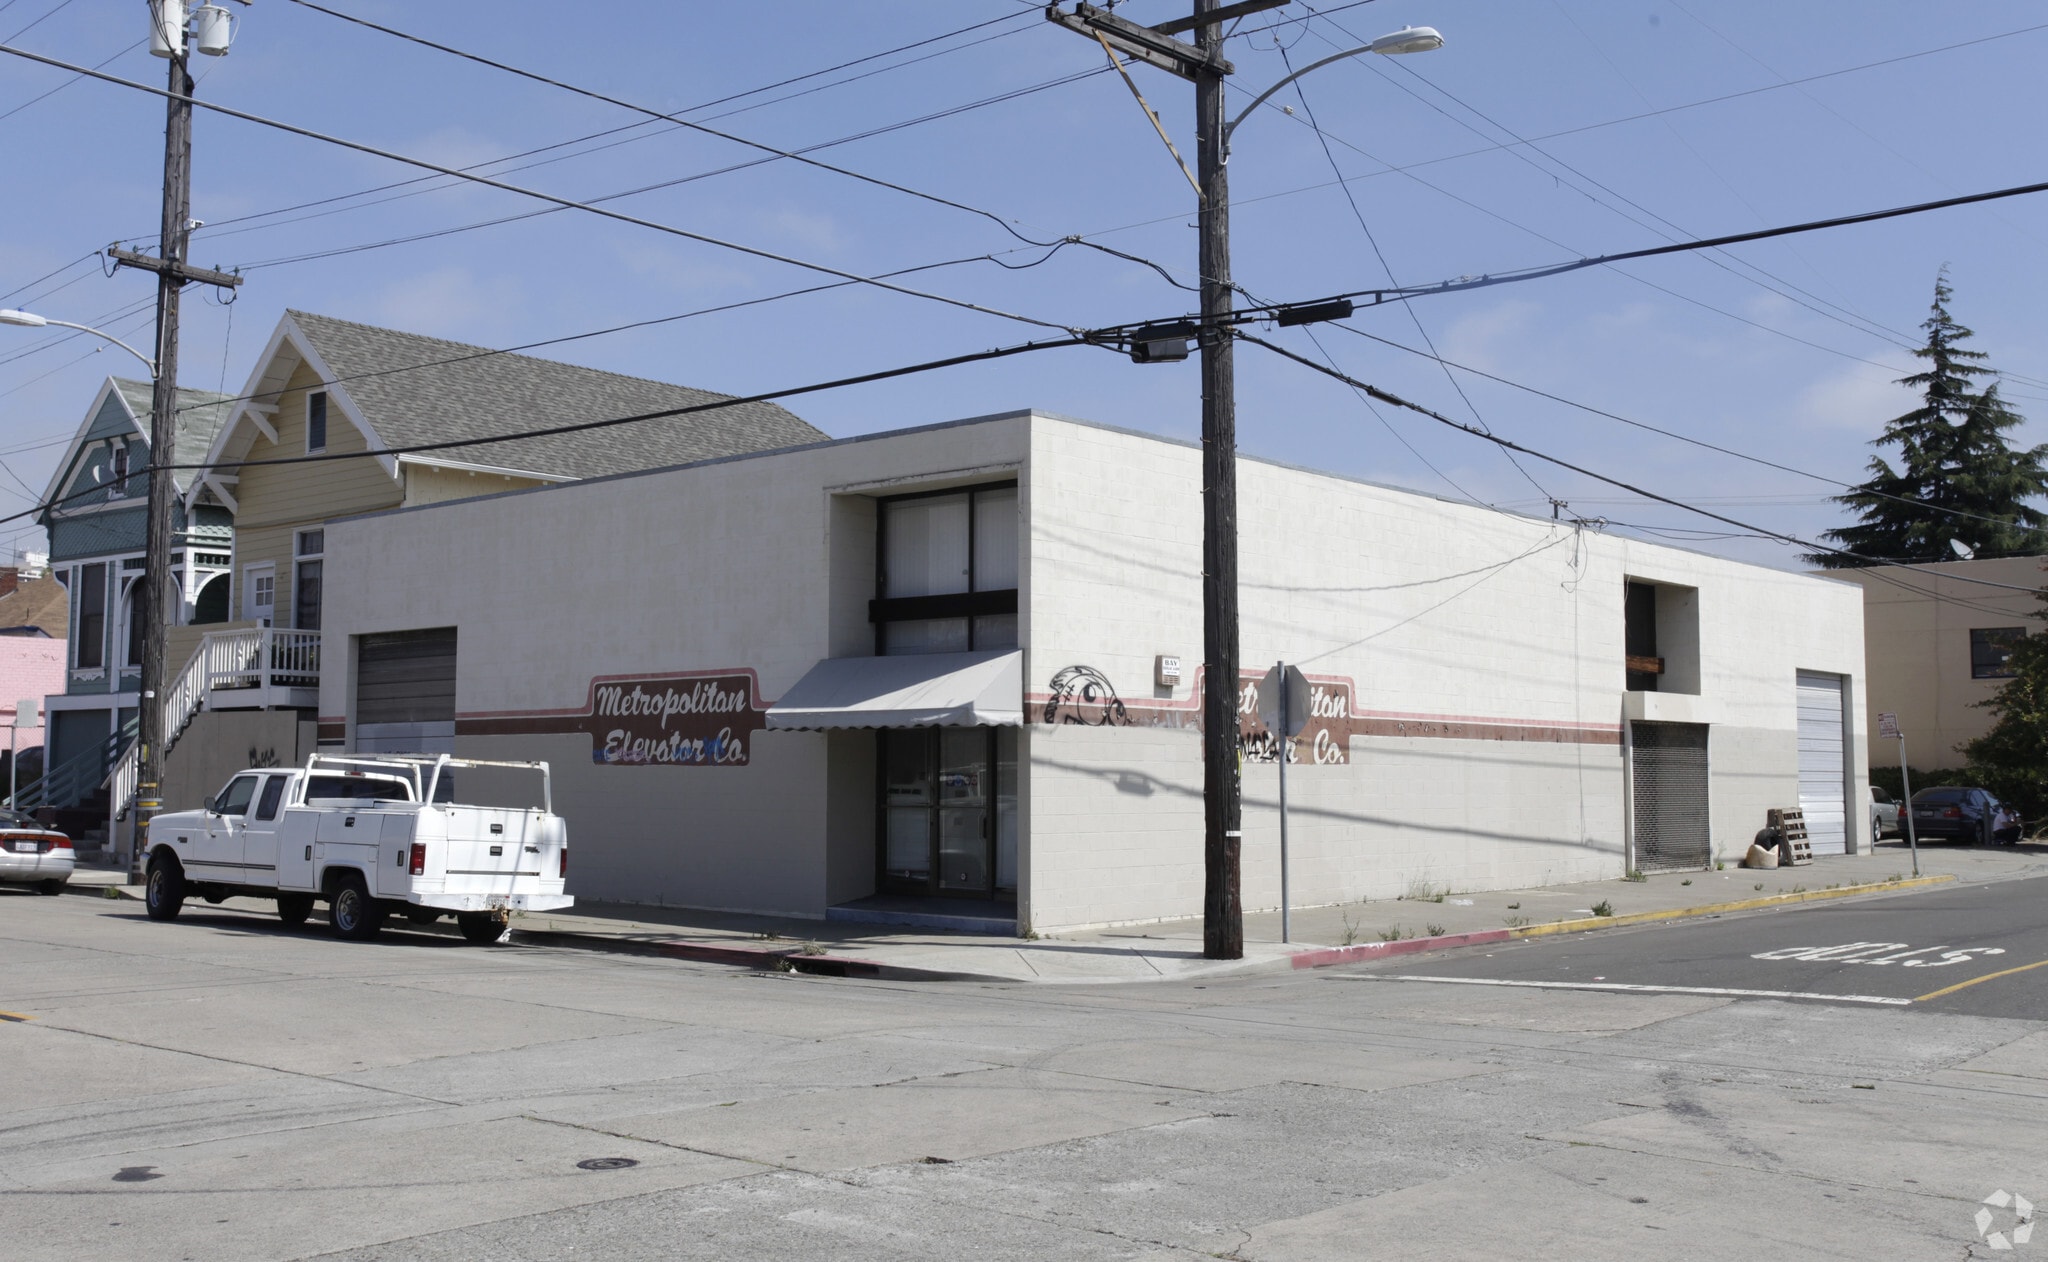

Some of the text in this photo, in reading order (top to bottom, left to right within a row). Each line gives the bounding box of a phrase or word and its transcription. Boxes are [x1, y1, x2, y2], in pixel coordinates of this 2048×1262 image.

[597, 681, 746, 730] Metropolitan
[603, 726, 747, 763] Elevator Co.
[1313, 728, 1345, 765] Co.
